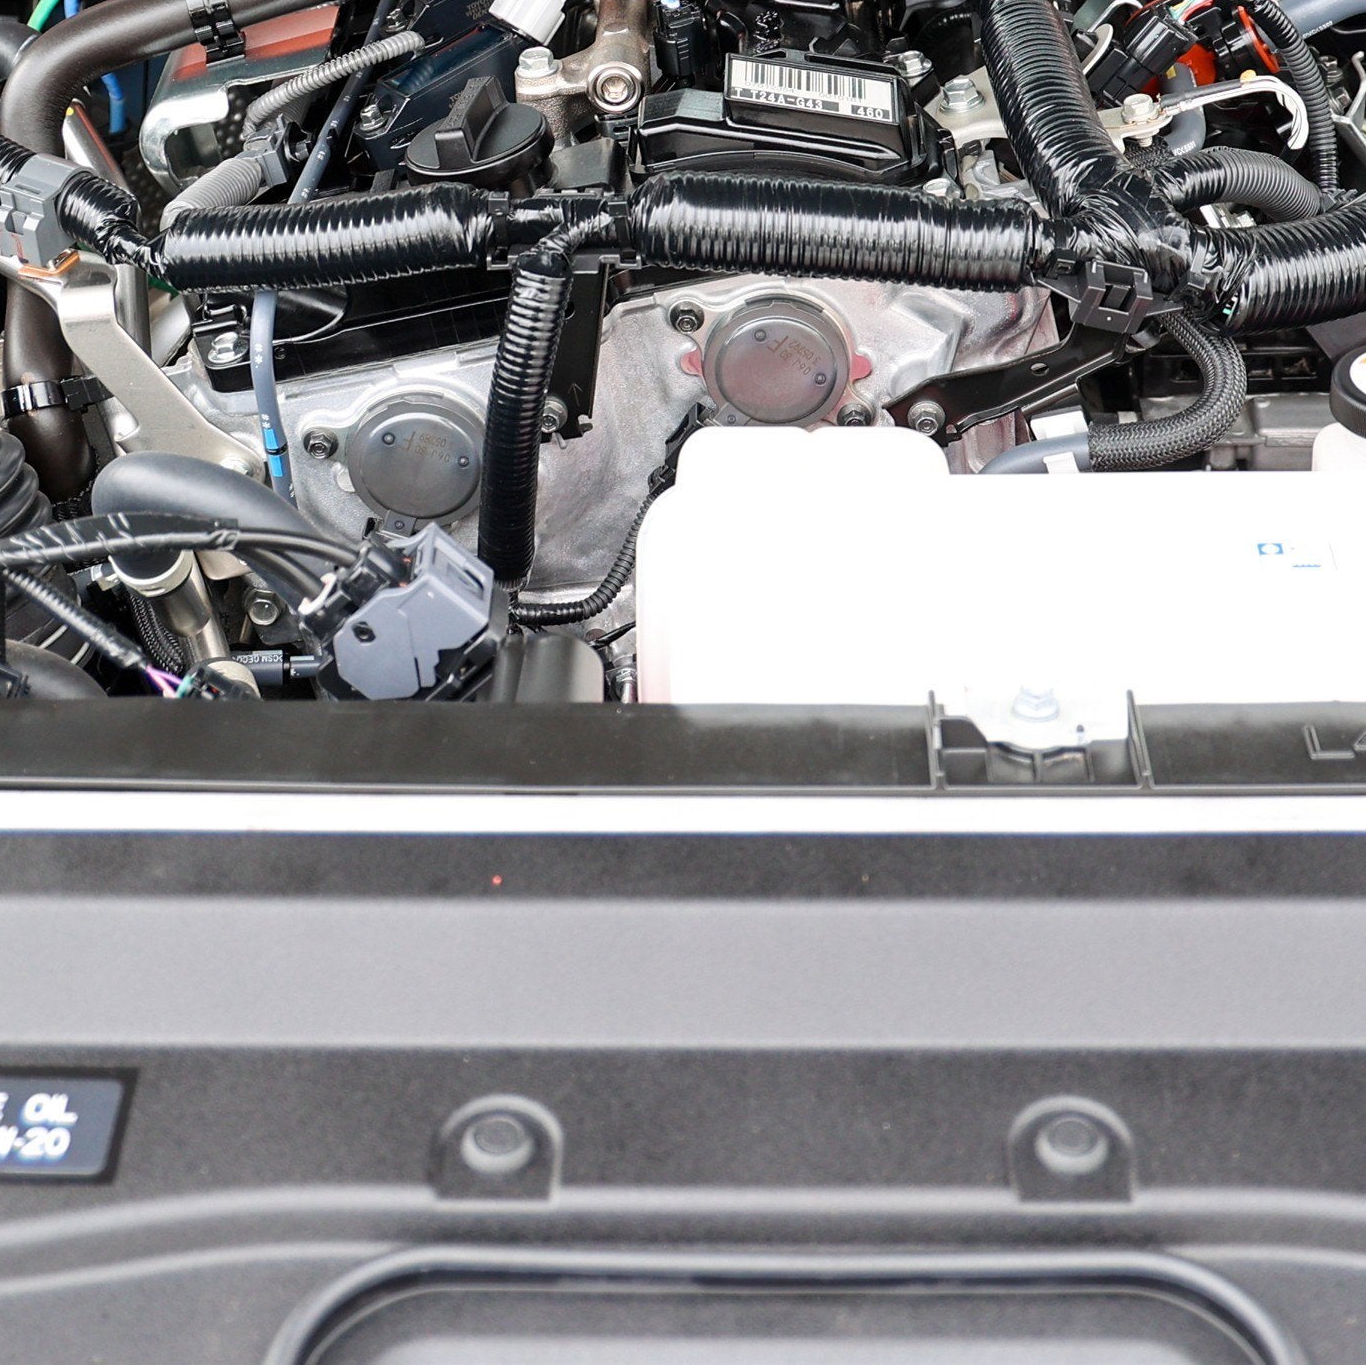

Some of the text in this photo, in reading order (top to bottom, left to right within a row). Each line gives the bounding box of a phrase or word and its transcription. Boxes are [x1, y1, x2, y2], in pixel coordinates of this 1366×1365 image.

[734, 88, 743, 99] T
[750, 90, 824, 110] T24A-G43
[857, 106, 884, 119] 460
[24, 1092, 78, 1125] OIL
